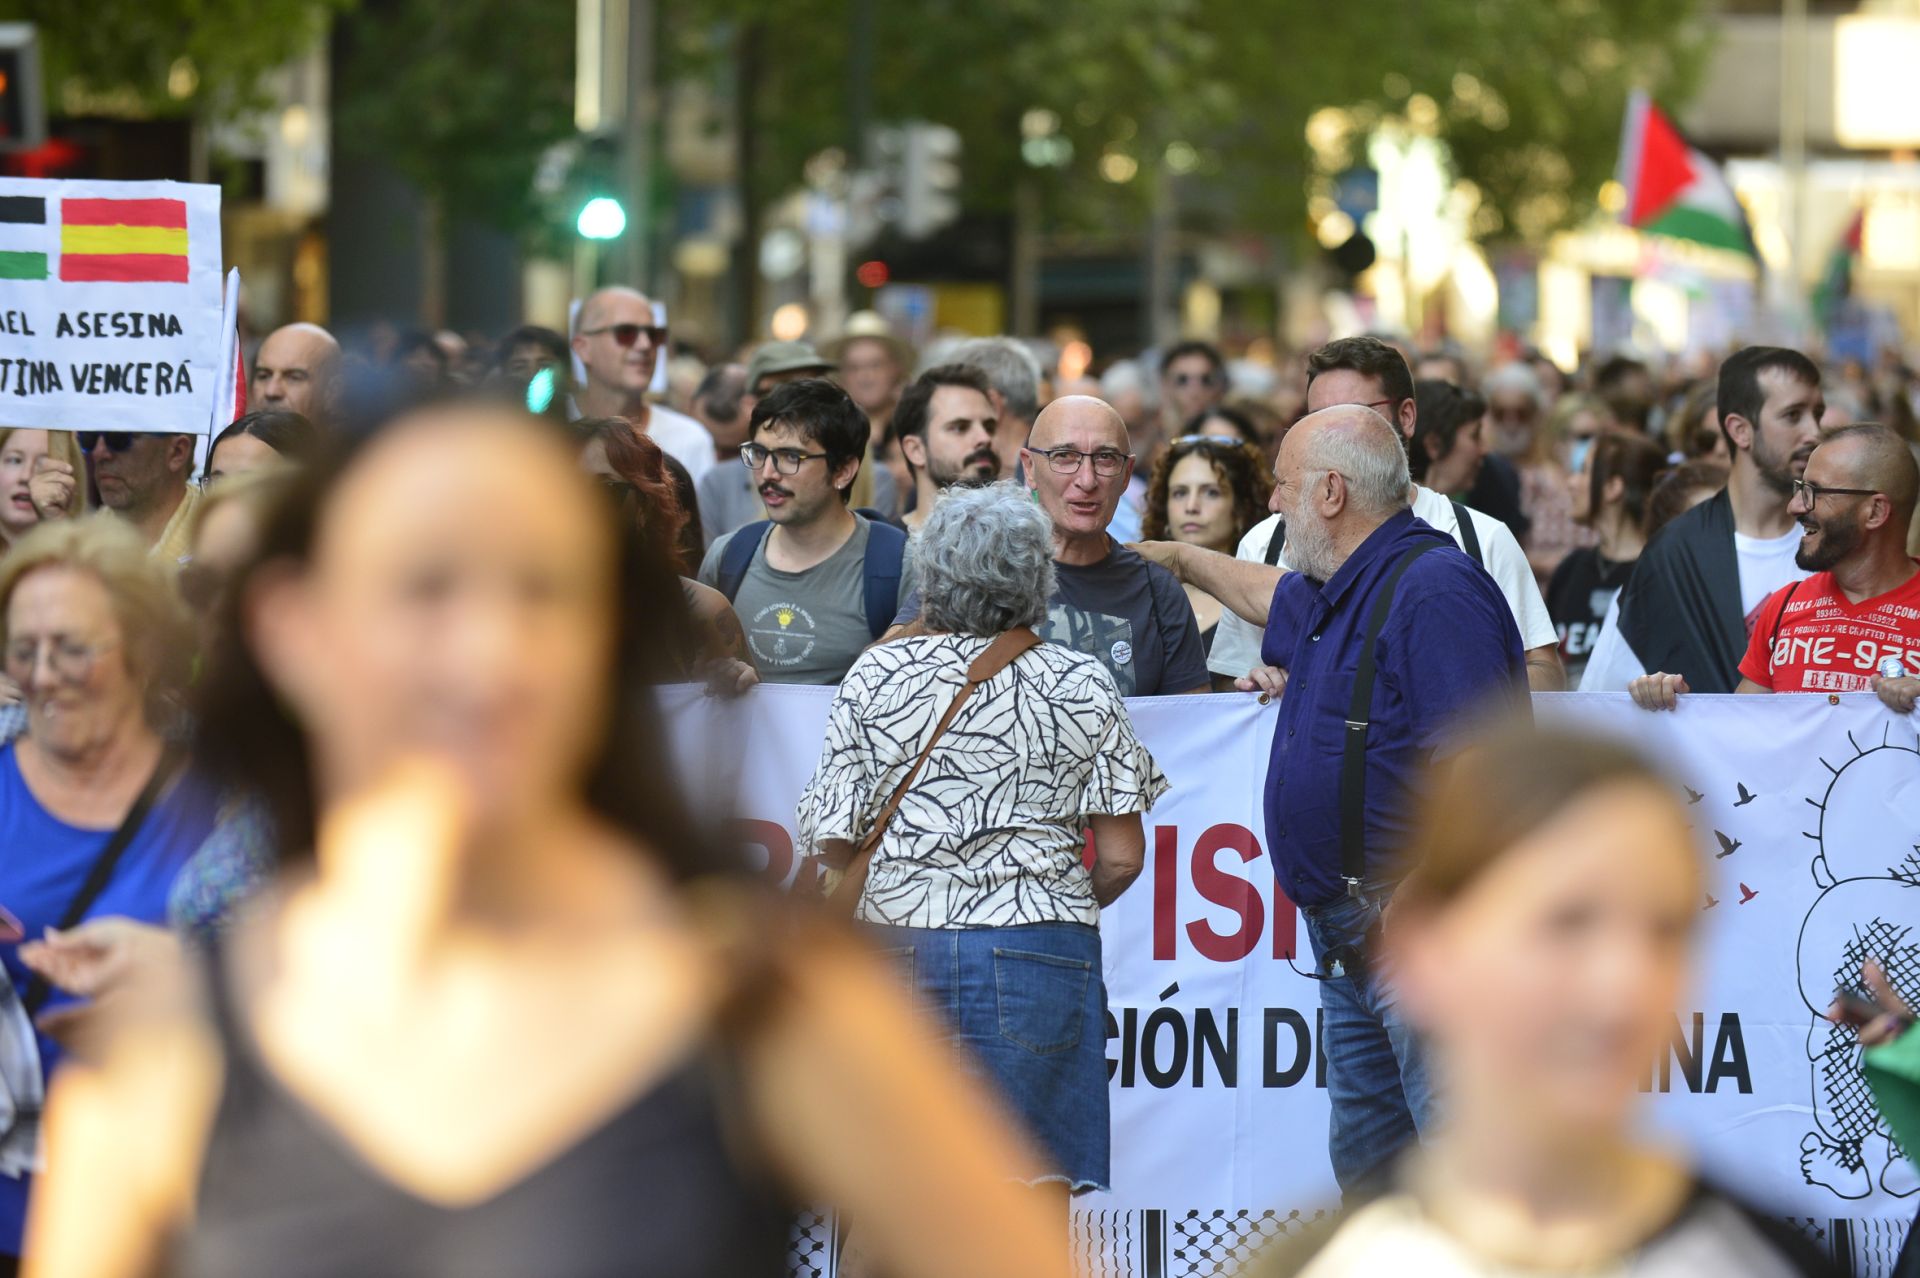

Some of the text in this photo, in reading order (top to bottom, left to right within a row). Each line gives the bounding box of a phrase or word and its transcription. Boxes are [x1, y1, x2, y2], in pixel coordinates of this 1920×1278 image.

[0, 311, 183, 338] EL ASESINA
[70, 359, 193, 396] VENCERÁ
[1810, 672, 1867, 692] DENIM
